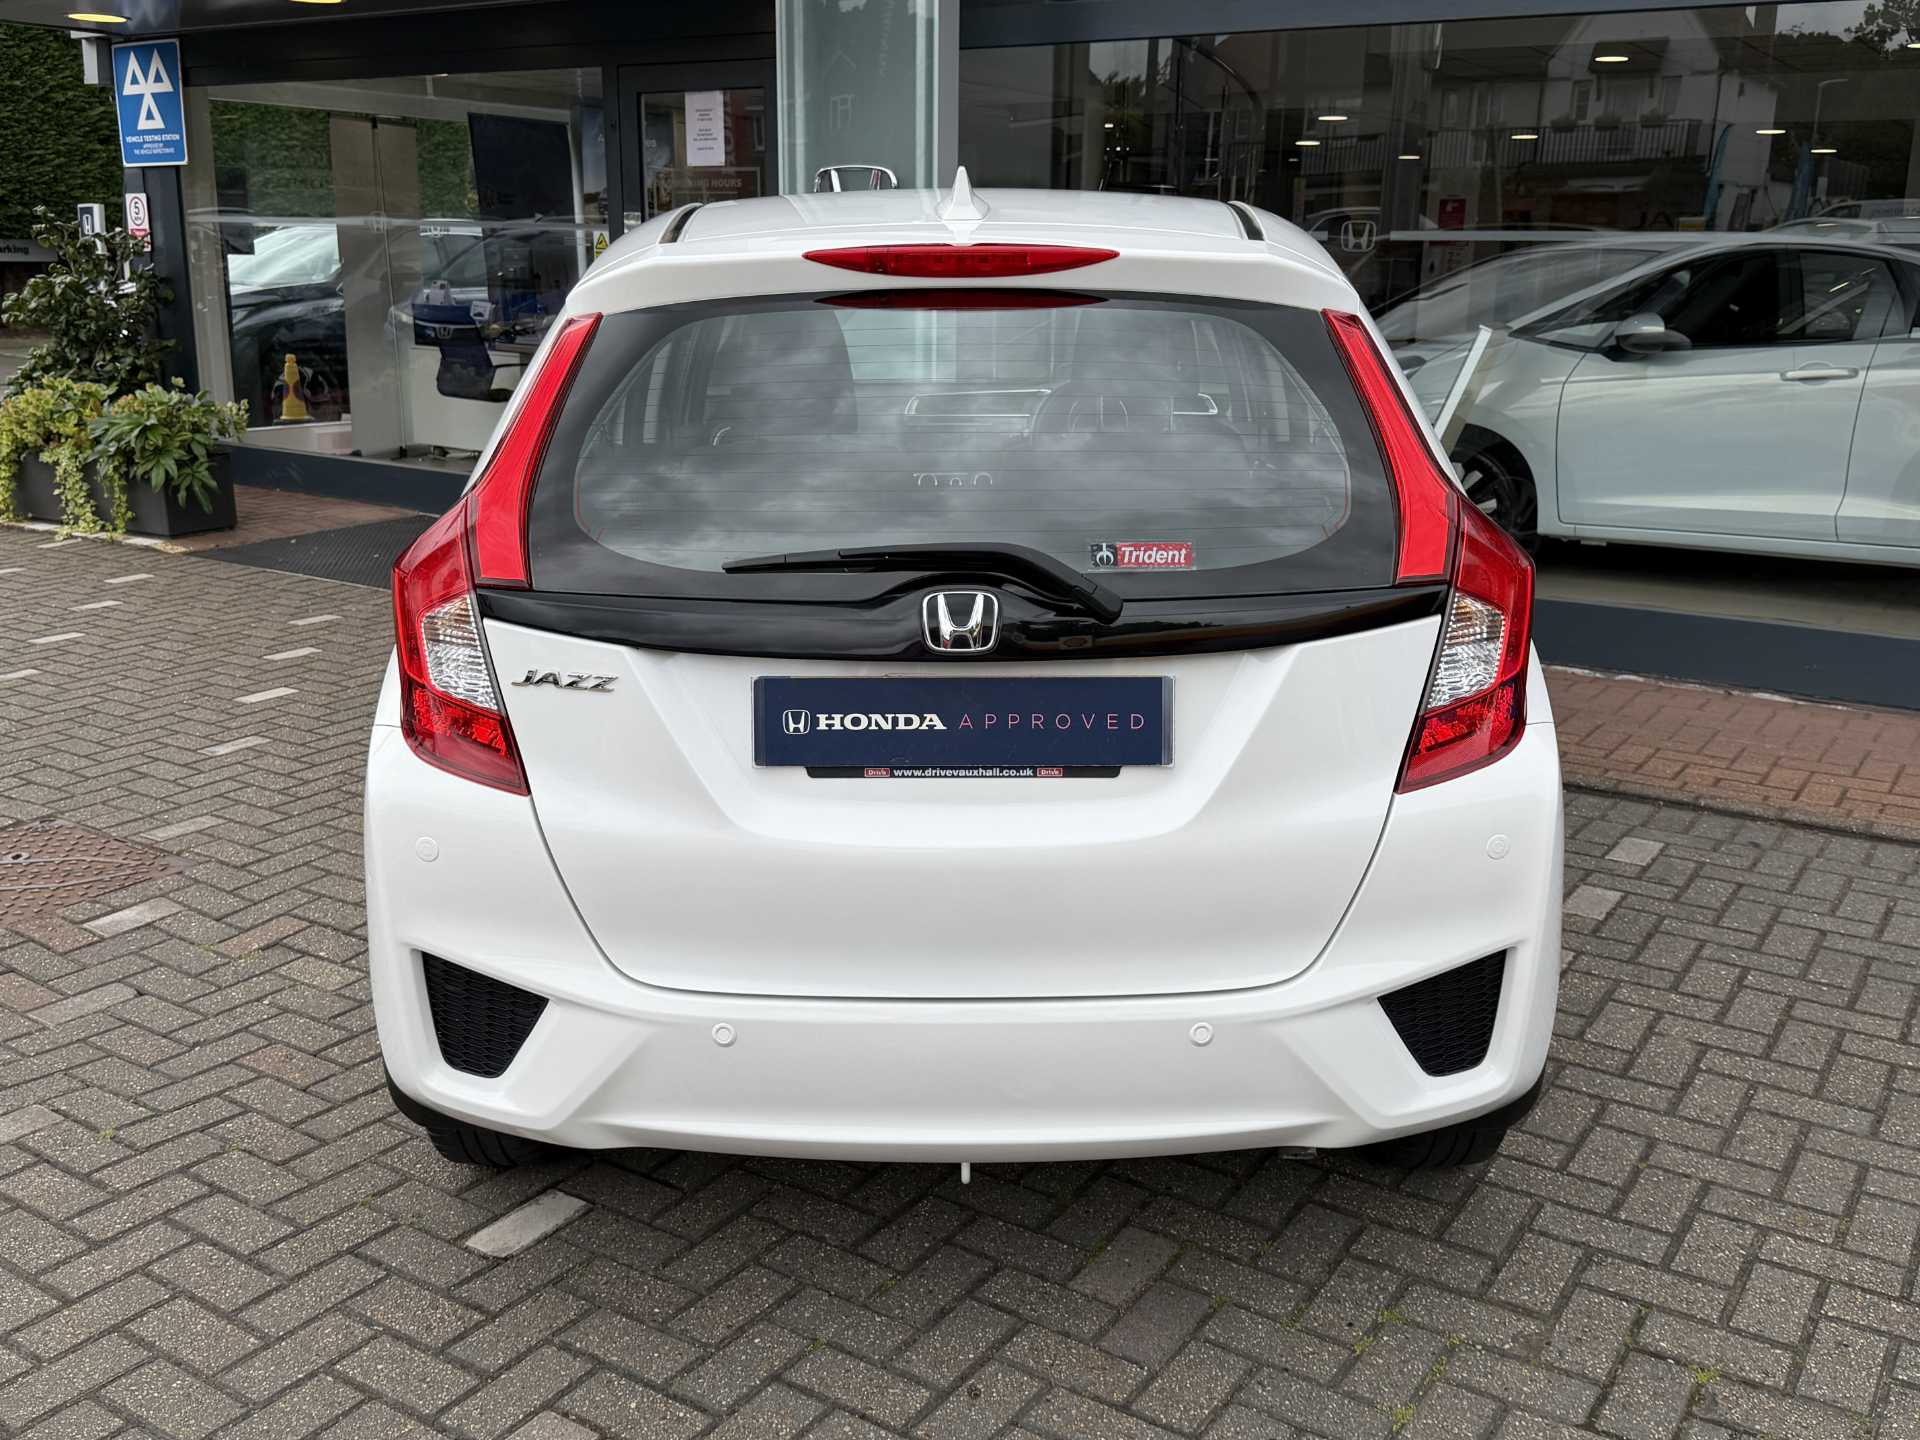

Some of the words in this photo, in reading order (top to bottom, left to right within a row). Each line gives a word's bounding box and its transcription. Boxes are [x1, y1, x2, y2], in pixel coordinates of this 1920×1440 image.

[133, 201, 140, 215] 5
[1121, 547, 1186, 563] Trident
[511, 669, 619, 693] JAZZ
[815, 713, 948, 731] HONDA
[958, 713, 1145, 730] APPROVED
[893, 767, 1034, 777] www.drivevauxhall.co.uk
